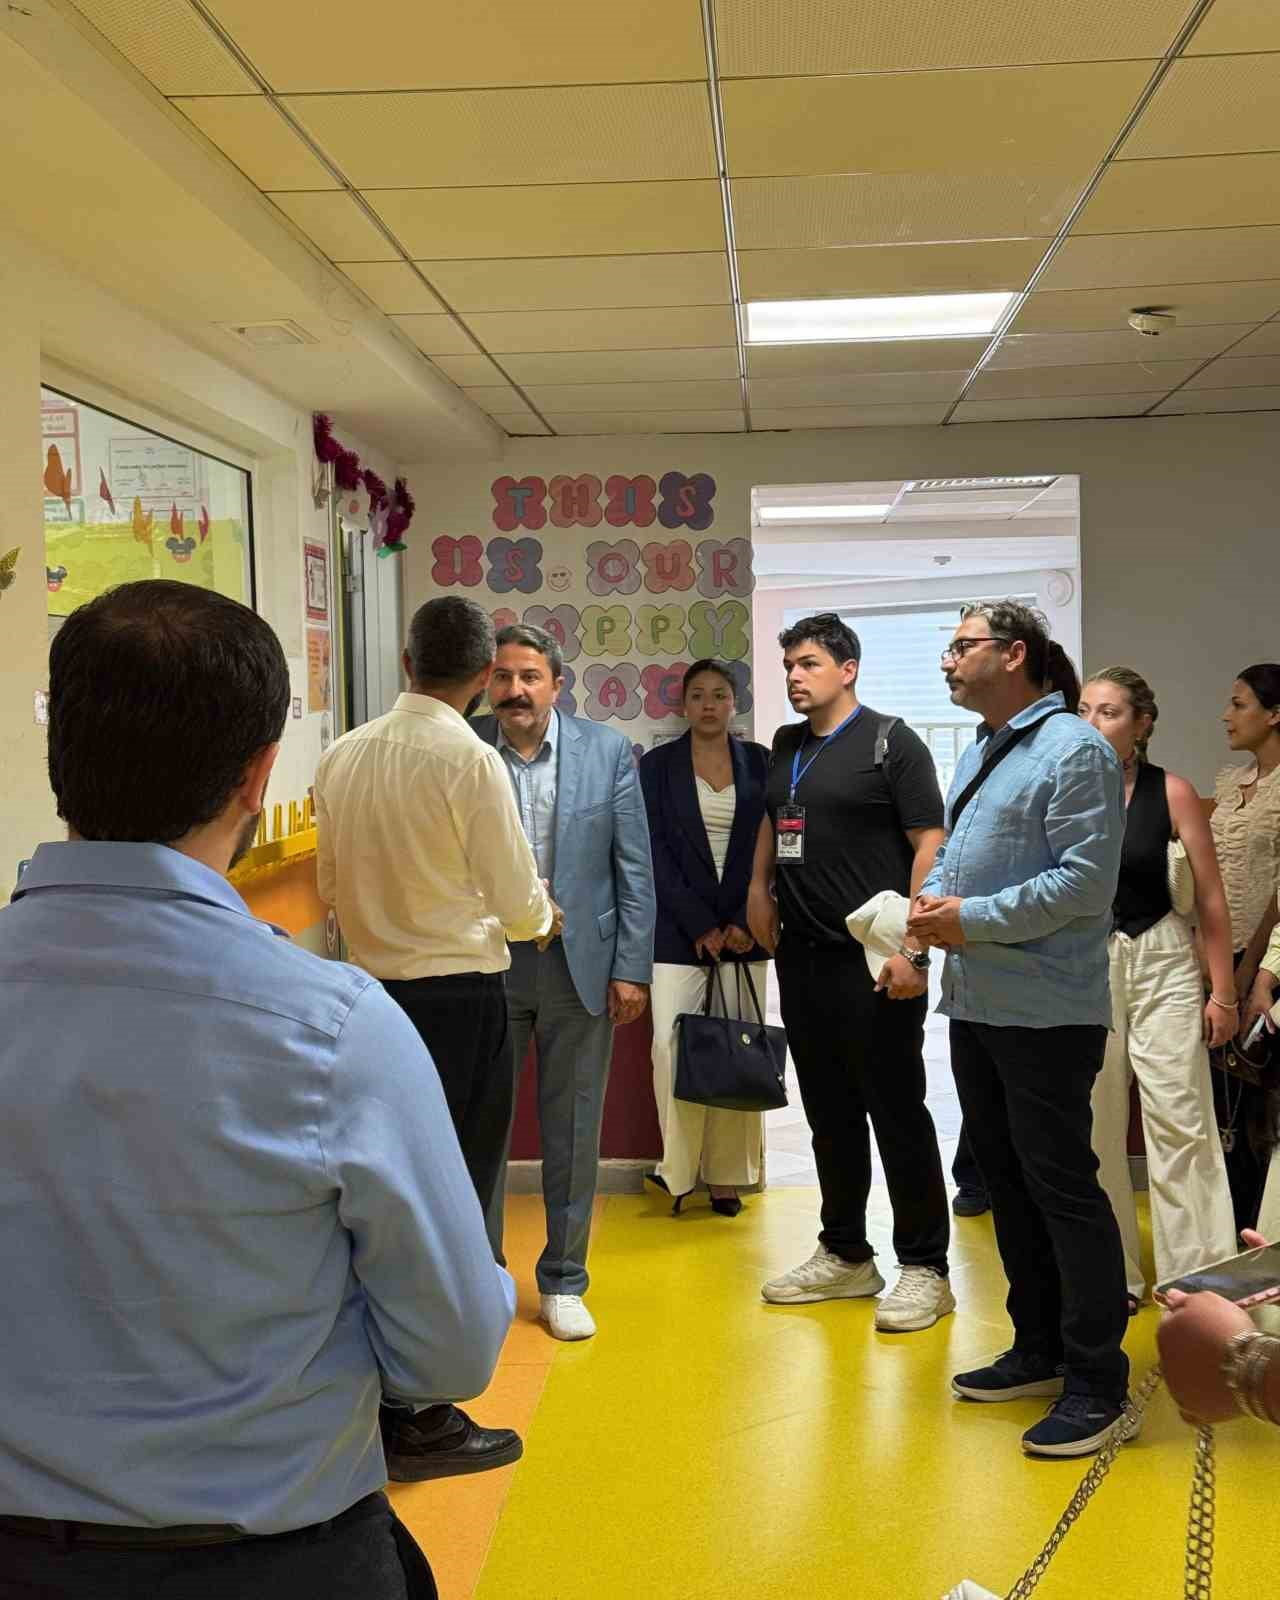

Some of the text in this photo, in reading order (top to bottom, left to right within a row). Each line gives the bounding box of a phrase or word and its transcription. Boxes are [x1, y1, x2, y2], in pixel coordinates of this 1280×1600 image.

[505, 482, 697, 520] THIS
[450, 545, 740, 589] IS OUR
[496, 607, 737, 648] APPY
